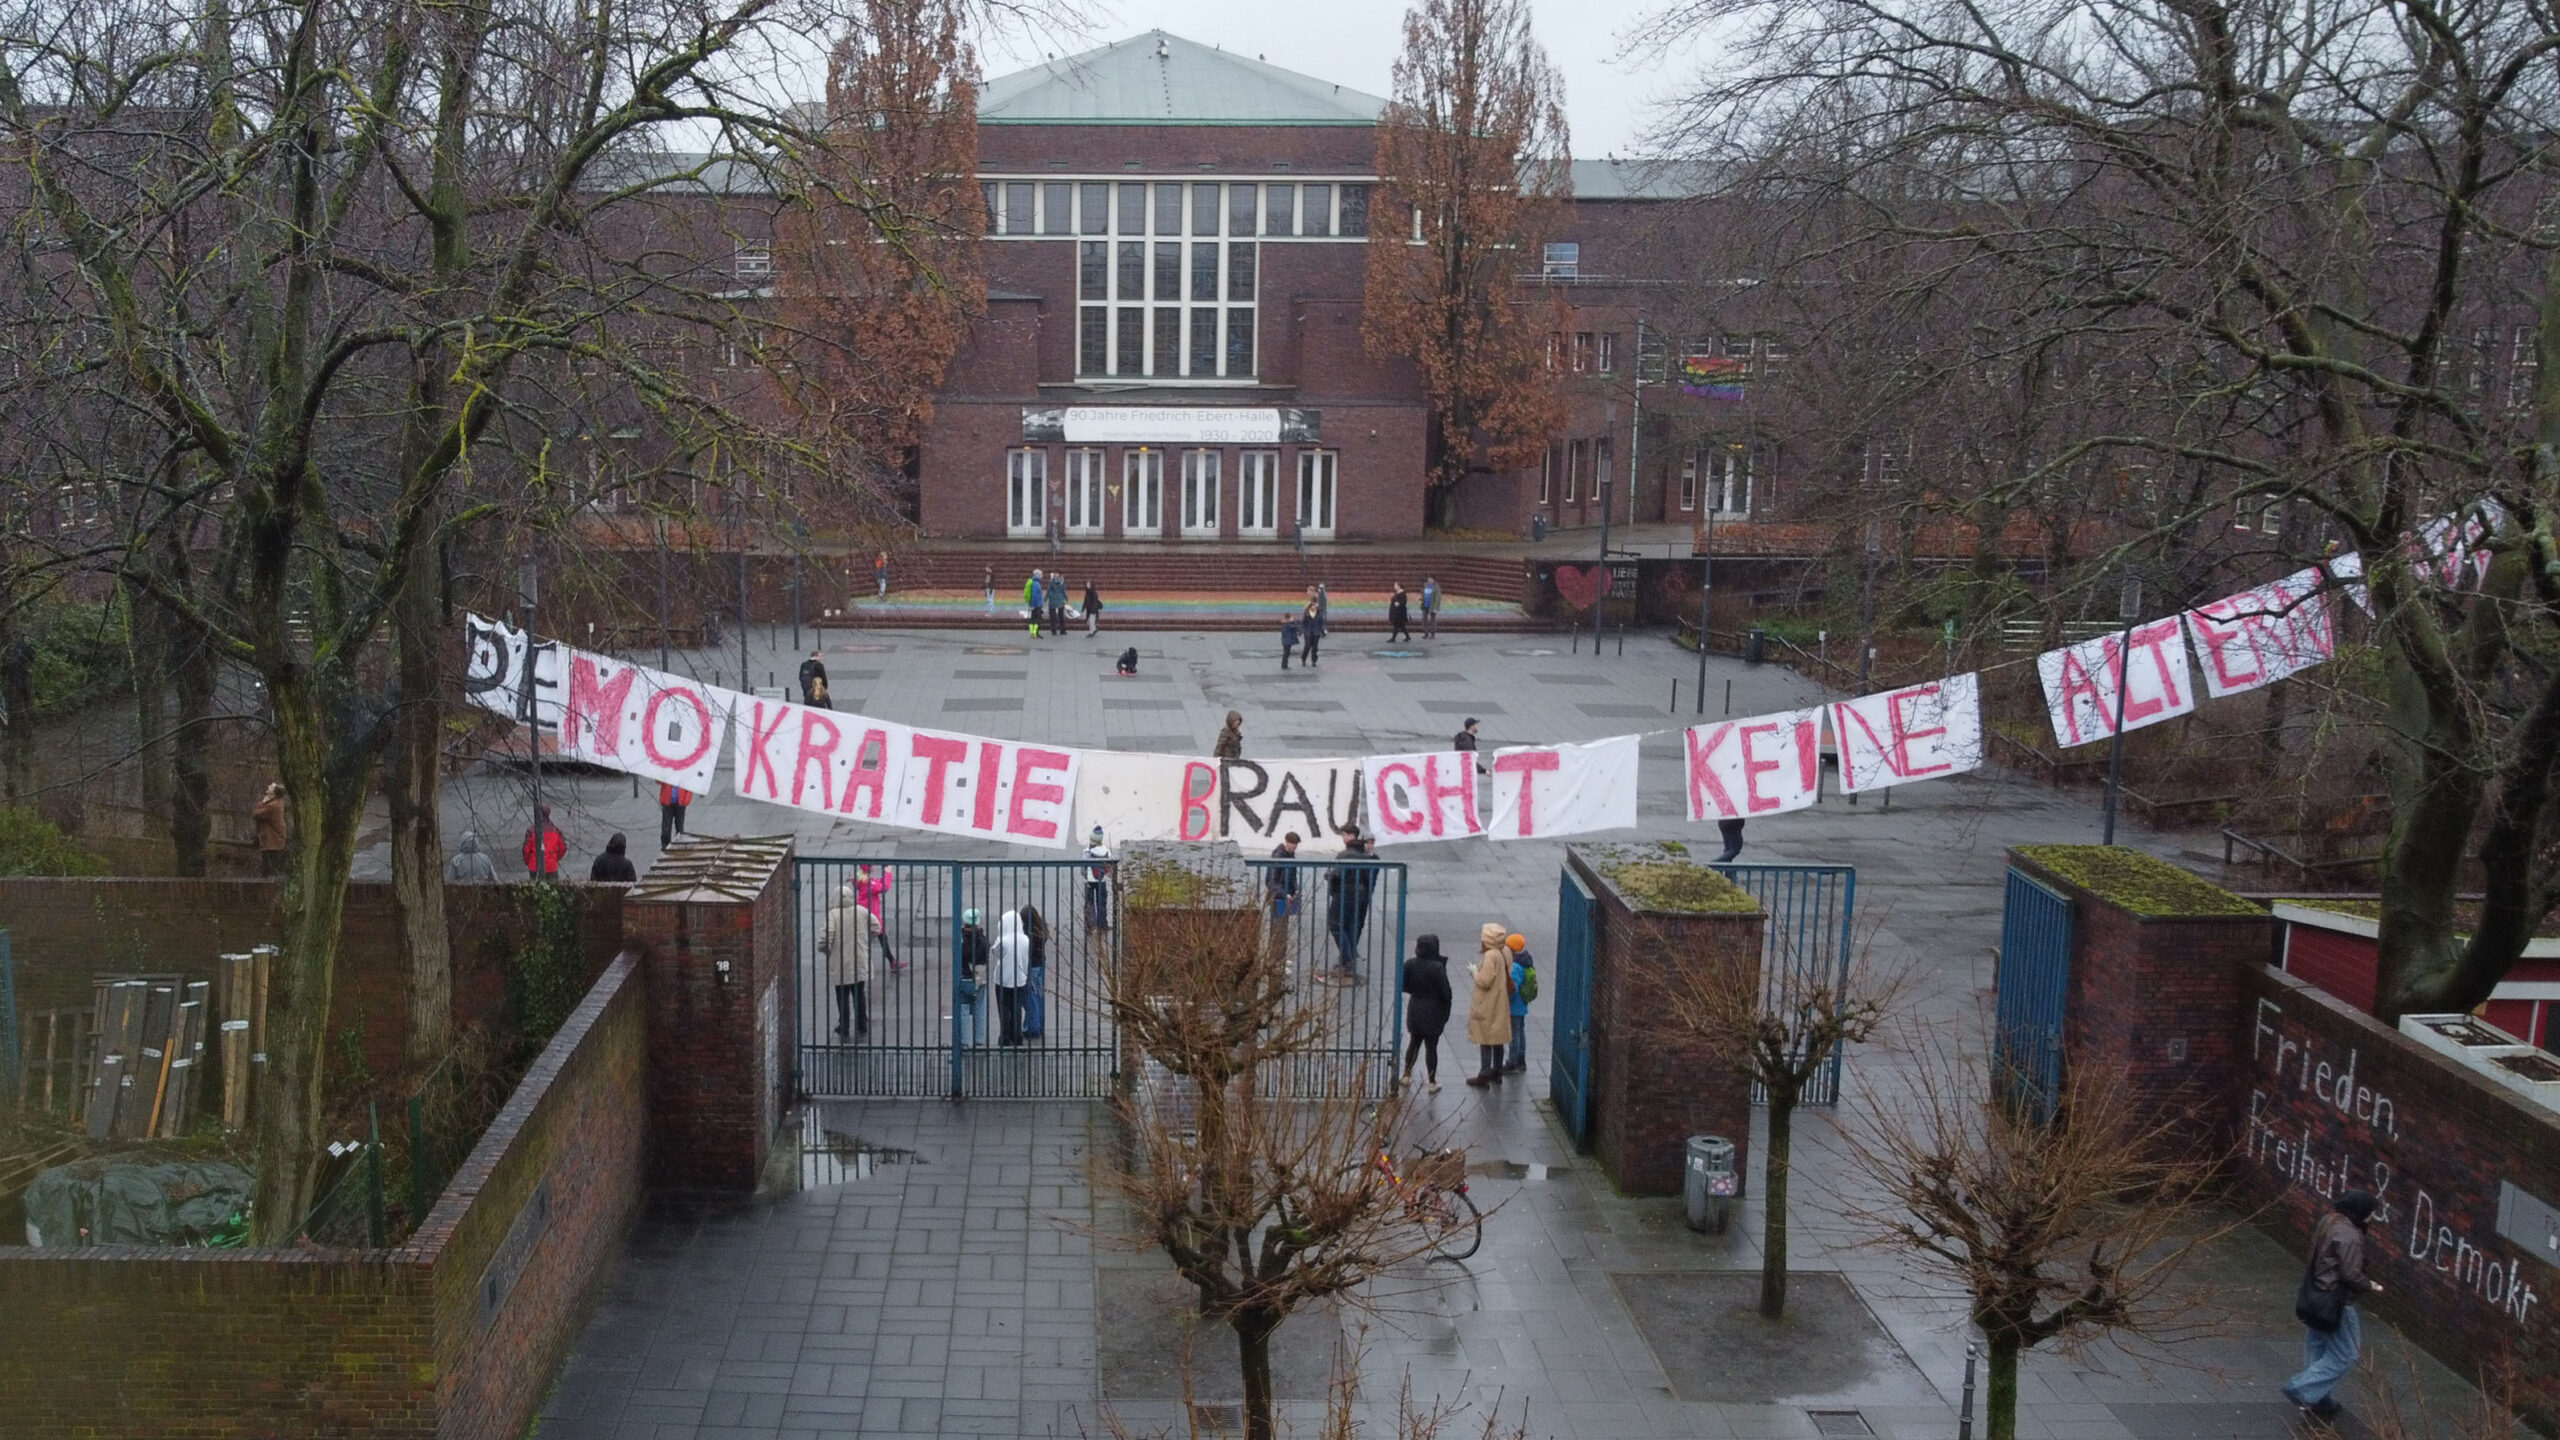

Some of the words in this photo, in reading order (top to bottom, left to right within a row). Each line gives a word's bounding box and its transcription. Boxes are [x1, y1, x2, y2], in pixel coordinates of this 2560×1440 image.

[1069, 410, 1088, 422] 90
[1090, 410, 1128, 422] Jahre
[1131, 410, 1274, 422] Friedrich-Ebert-Halle
[1199, 430, 1229, 441] 1930
[1241, 430, 1273, 441] 2020
[1179, 751, 1560, 841] BRAUCHT
[1686, 685, 1951, 820] KEINE
[716, 960, 730, 972] 38
[2253, 997, 2399, 1143] Frieden,
[2247, 1089, 2350, 1200] Freiheit
[2366, 1161, 2390, 1224] &
